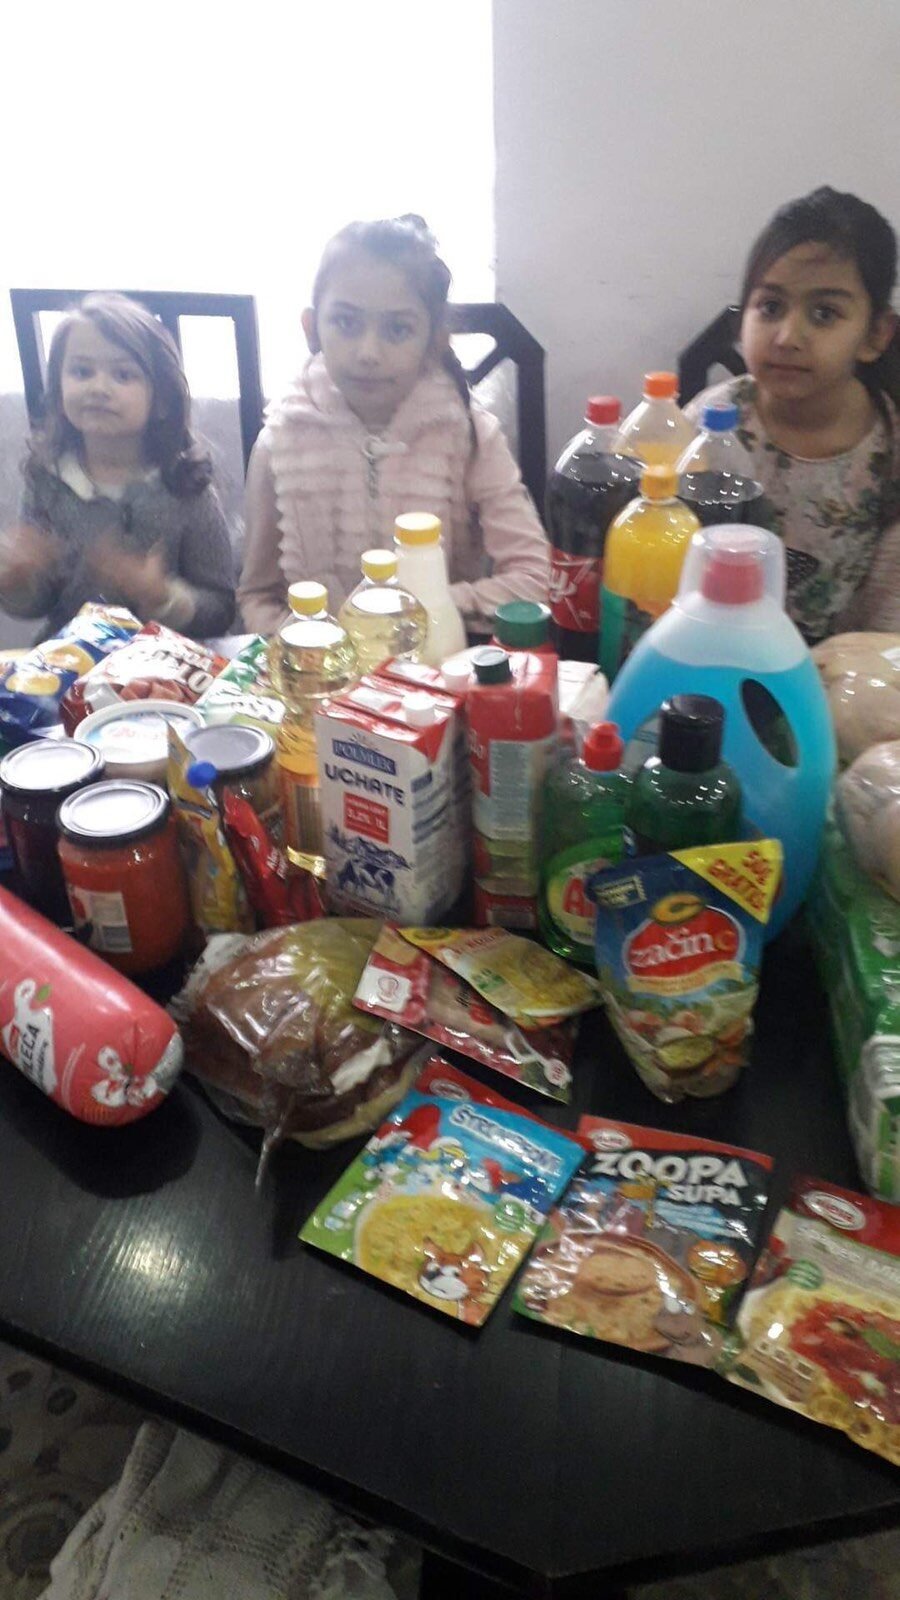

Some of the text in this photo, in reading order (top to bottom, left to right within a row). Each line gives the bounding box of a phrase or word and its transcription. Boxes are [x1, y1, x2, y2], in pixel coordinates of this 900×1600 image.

[324, 763, 405, 807] UCHATE
[591, 1150, 750, 1188] ZOOPA
[666, 1184, 743, 1207] SUPA
